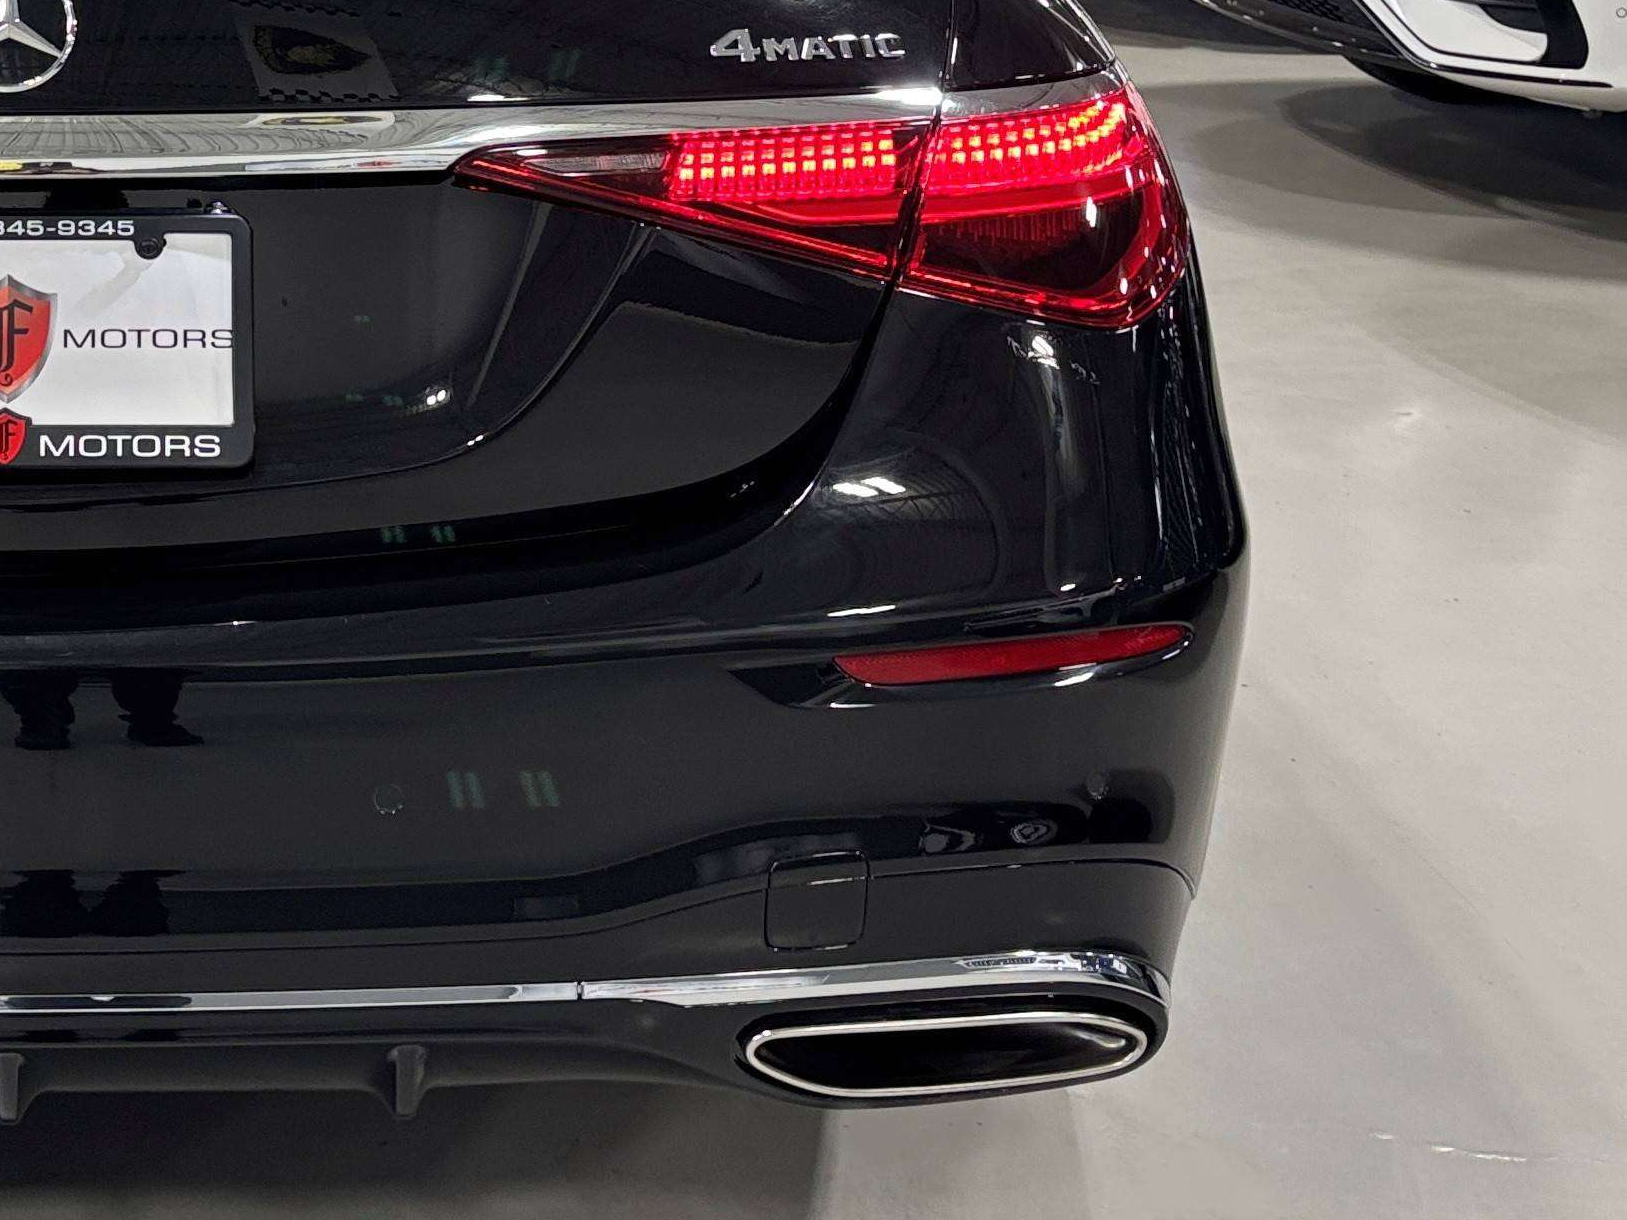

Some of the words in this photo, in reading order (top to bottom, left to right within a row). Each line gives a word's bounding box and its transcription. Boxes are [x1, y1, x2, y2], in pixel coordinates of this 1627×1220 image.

[709, 28, 906, 63] 4MATIC
[62, 328, 234, 350] MOTORS
[39, 434, 221, 459] MOTORS
